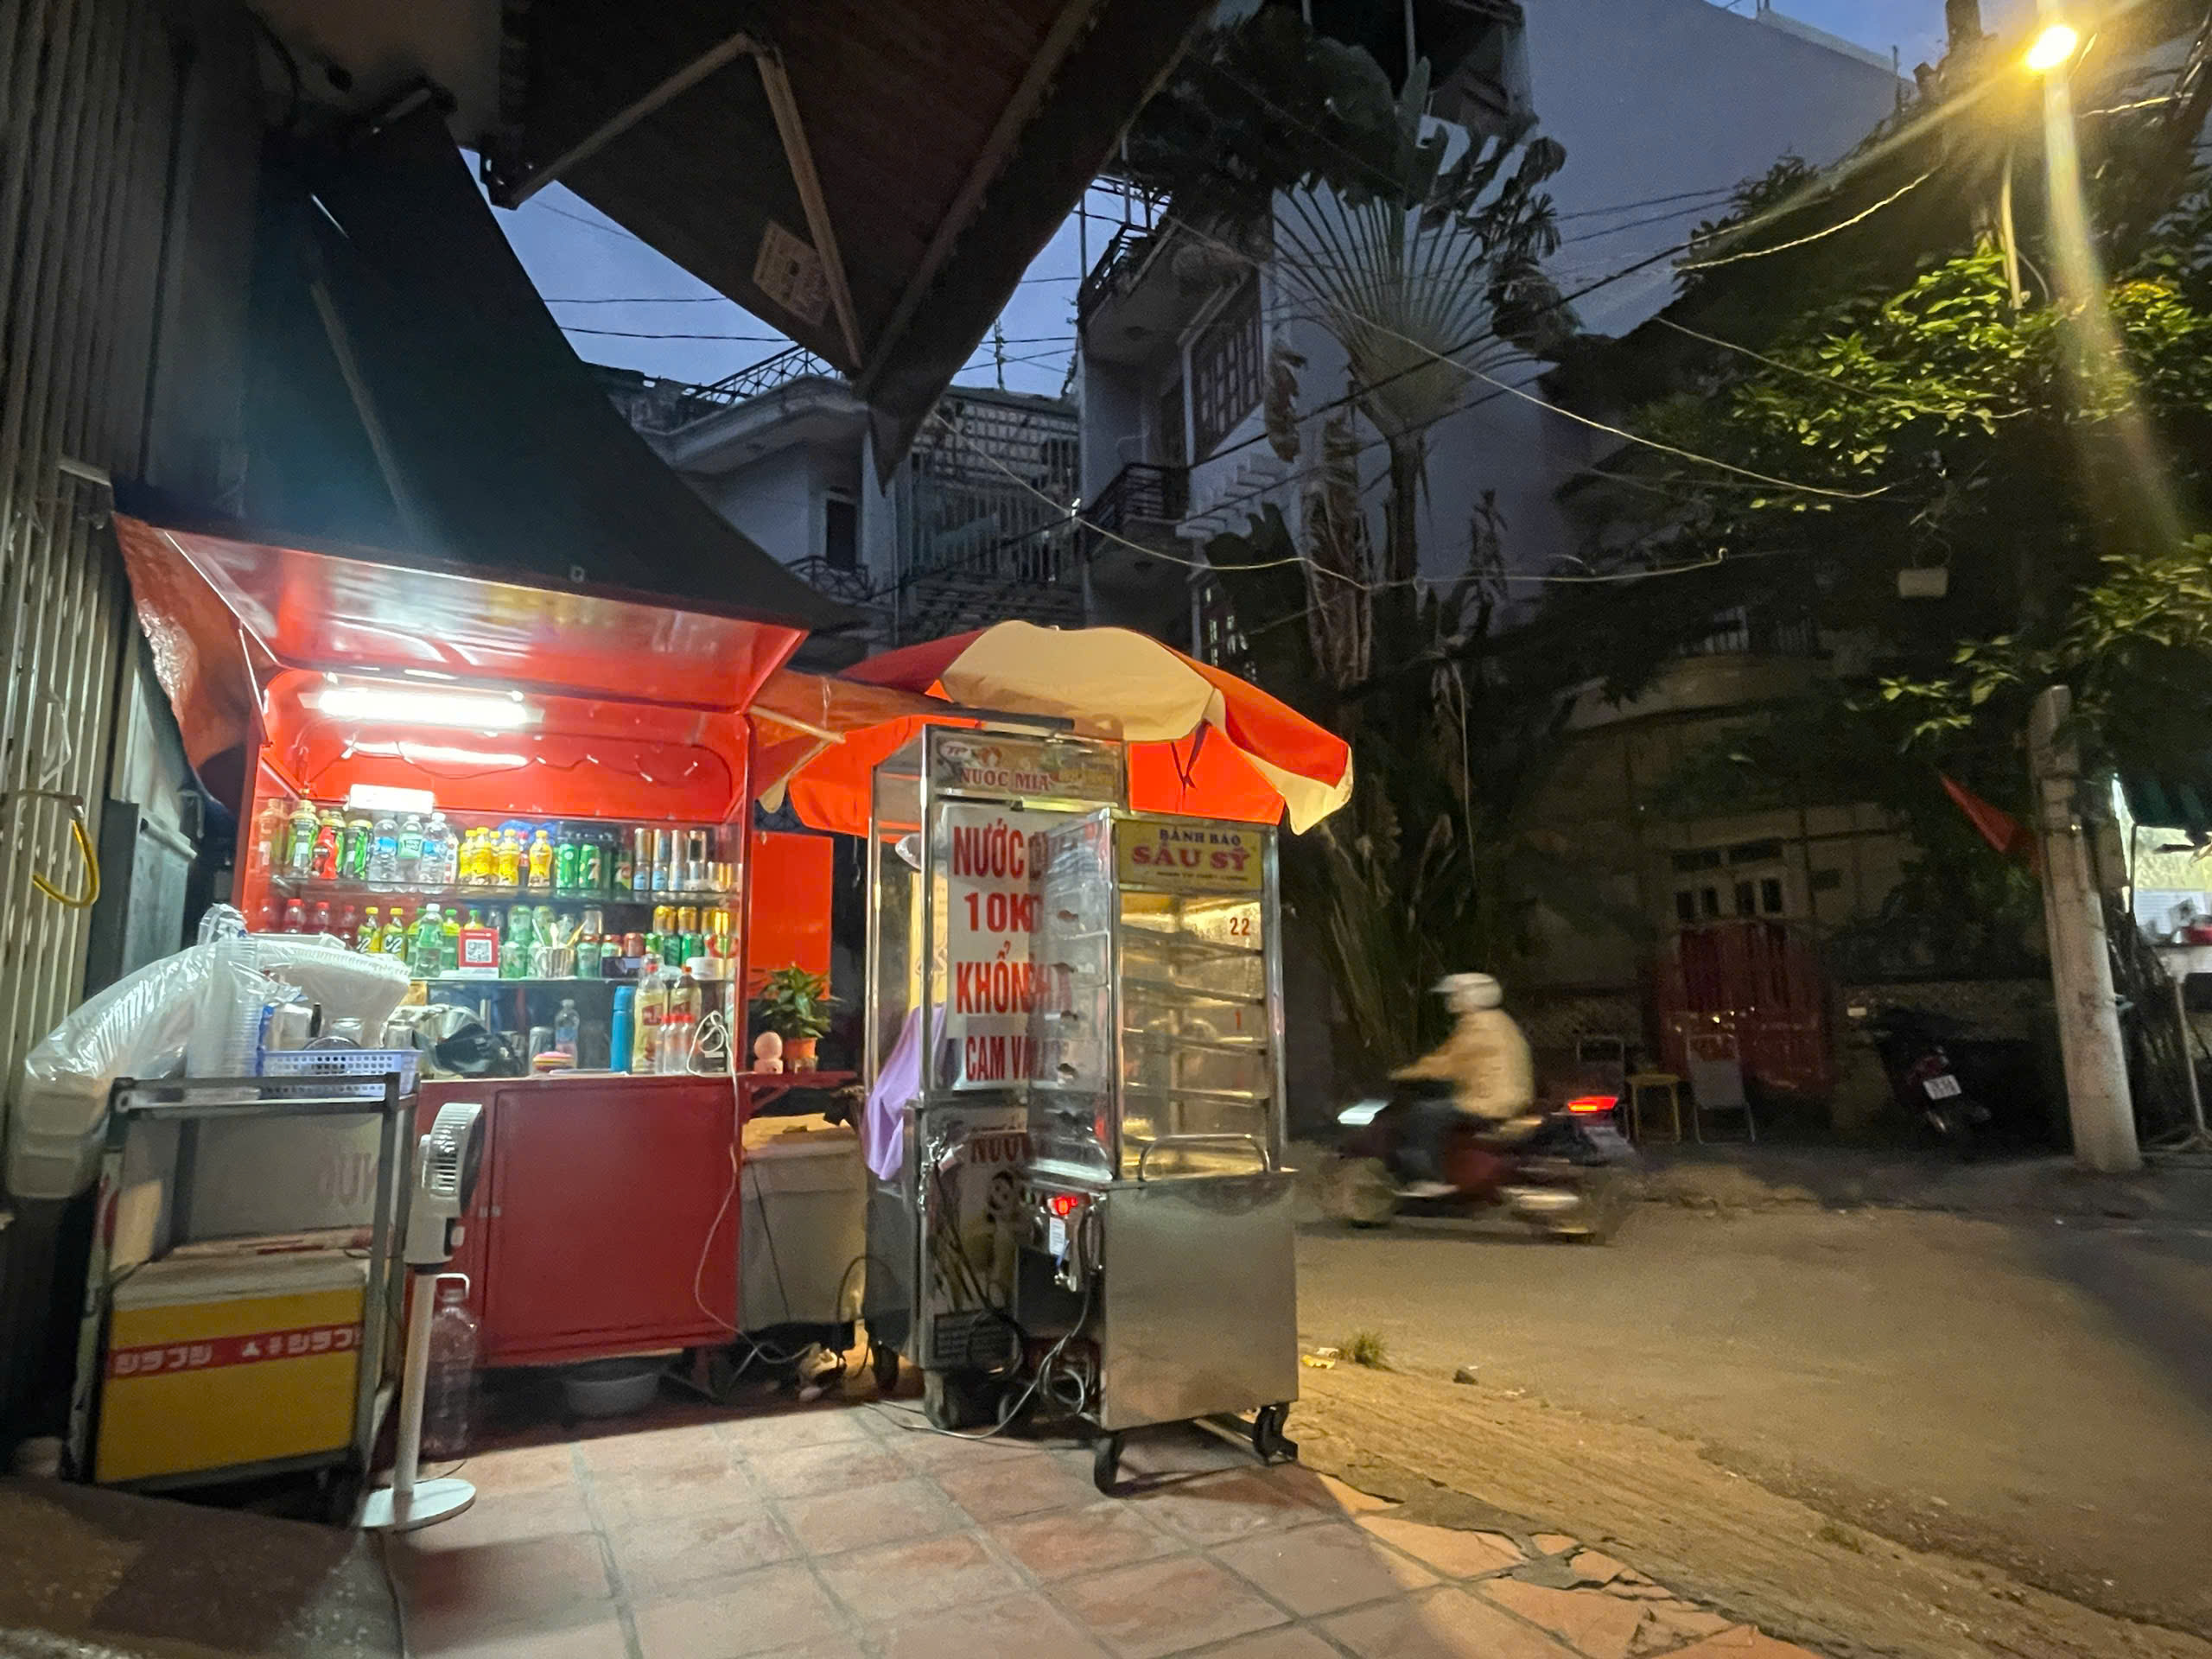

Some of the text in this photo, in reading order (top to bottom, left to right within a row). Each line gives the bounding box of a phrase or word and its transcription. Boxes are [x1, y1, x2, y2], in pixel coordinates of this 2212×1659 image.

[953, 817, 1024, 878] NƯỚC
[1230, 918, 1250, 936] 22
[385, 934, 403, 953] C2
[966, 1035, 1006, 1081] CAM
